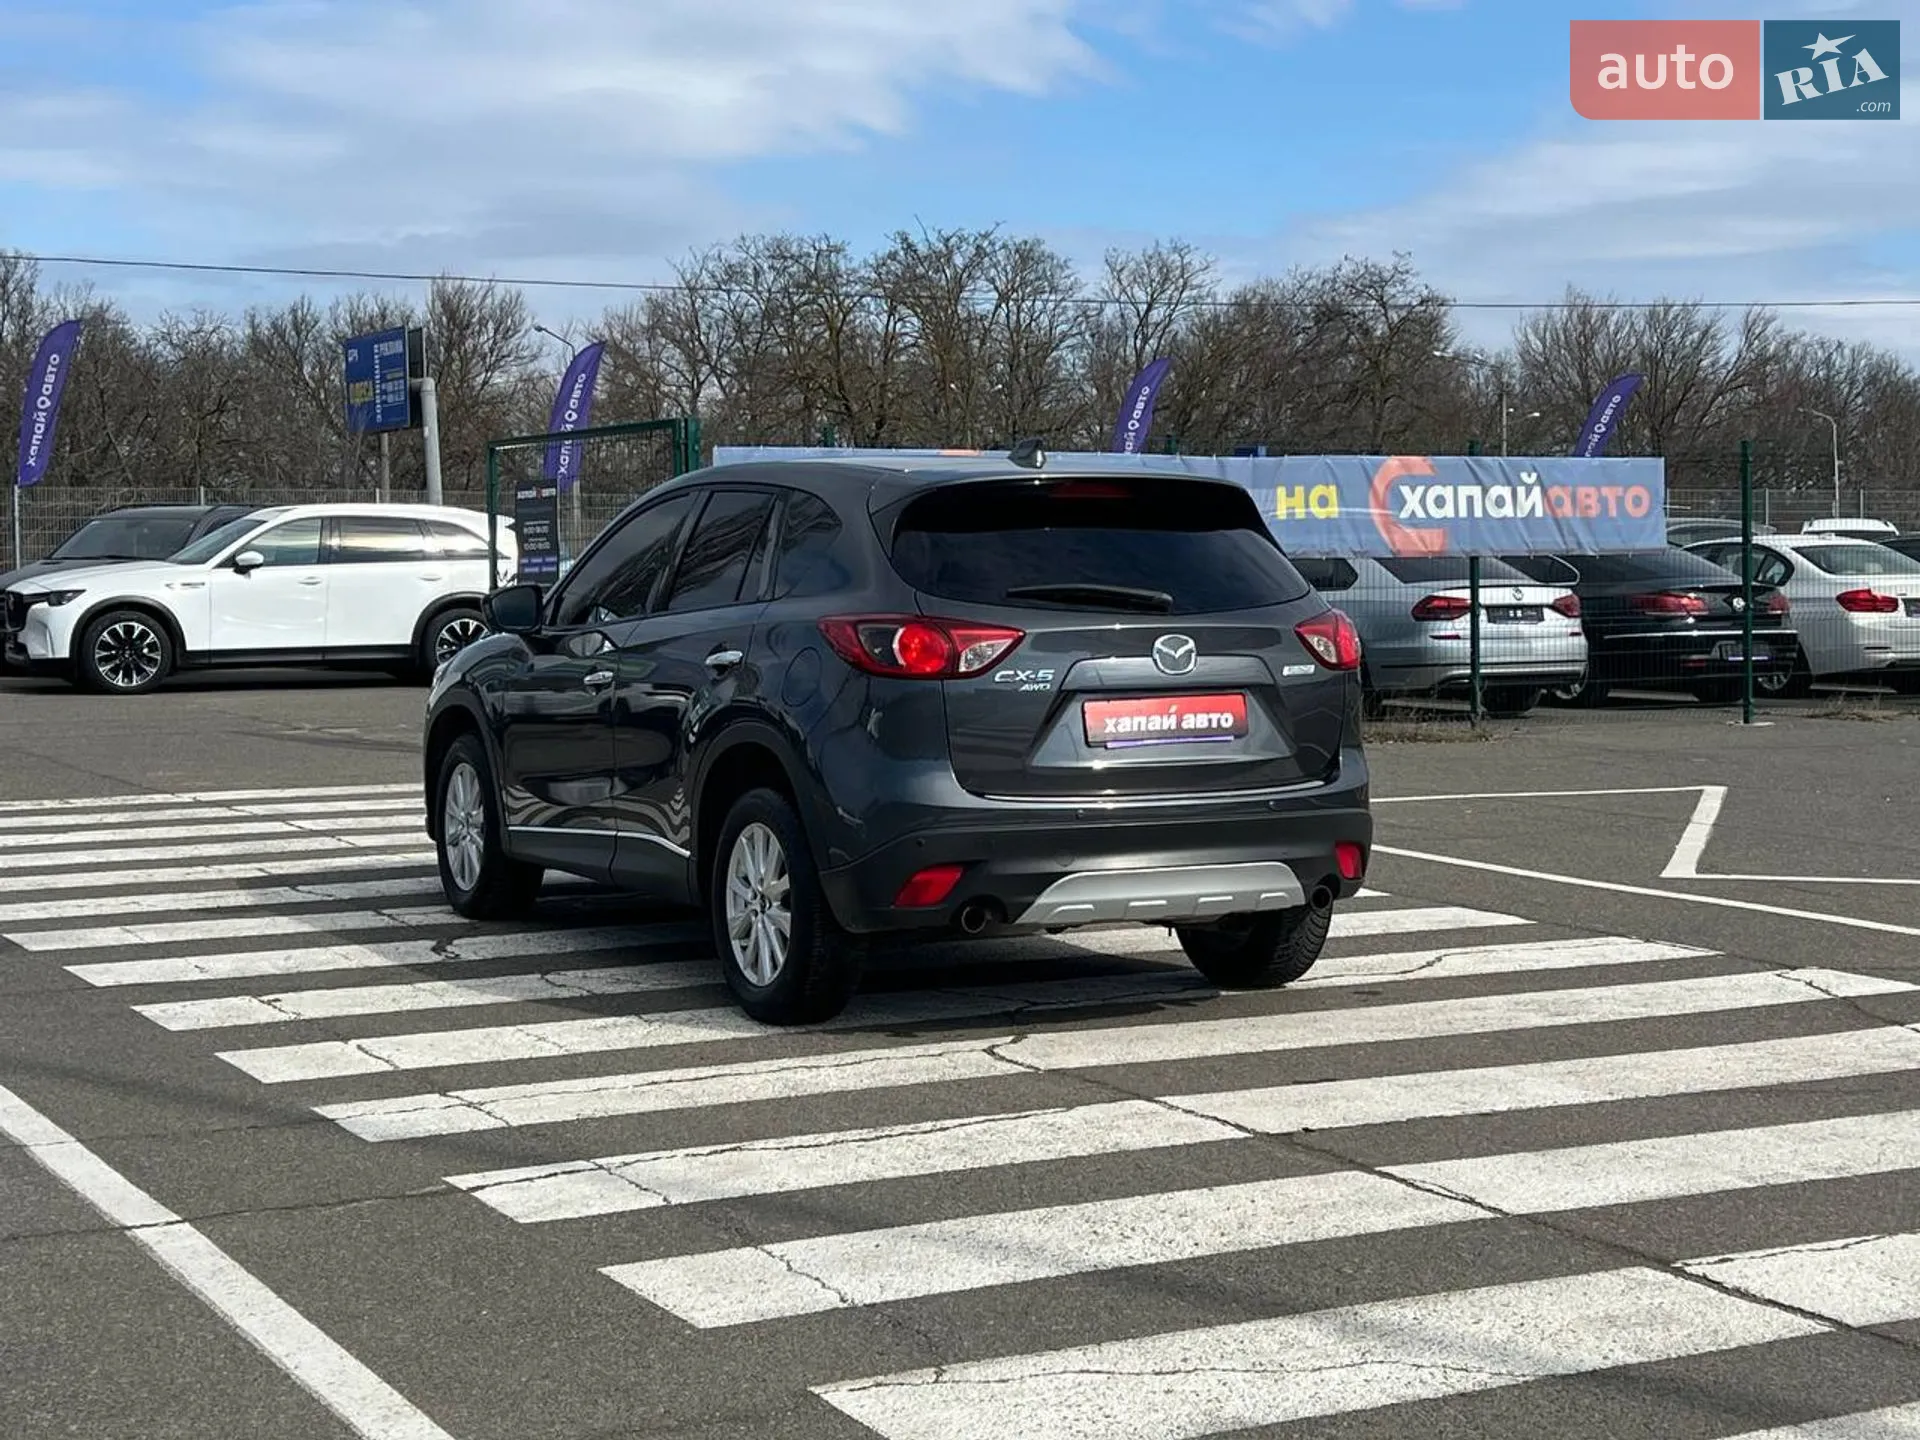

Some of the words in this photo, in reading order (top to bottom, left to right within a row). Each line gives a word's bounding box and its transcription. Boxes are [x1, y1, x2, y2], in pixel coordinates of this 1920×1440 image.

[41, 353, 60, 395] авто
[569, 373, 587, 409] авто
[1132, 386, 1150, 419] авто
[1600, 394, 1622, 423] авто
[1275, 483, 1340, 520] на
[994, 668, 1056, 682] CX-5
[1019, 683, 1051, 692] AWD
[1181, 711, 1234, 731] авто
